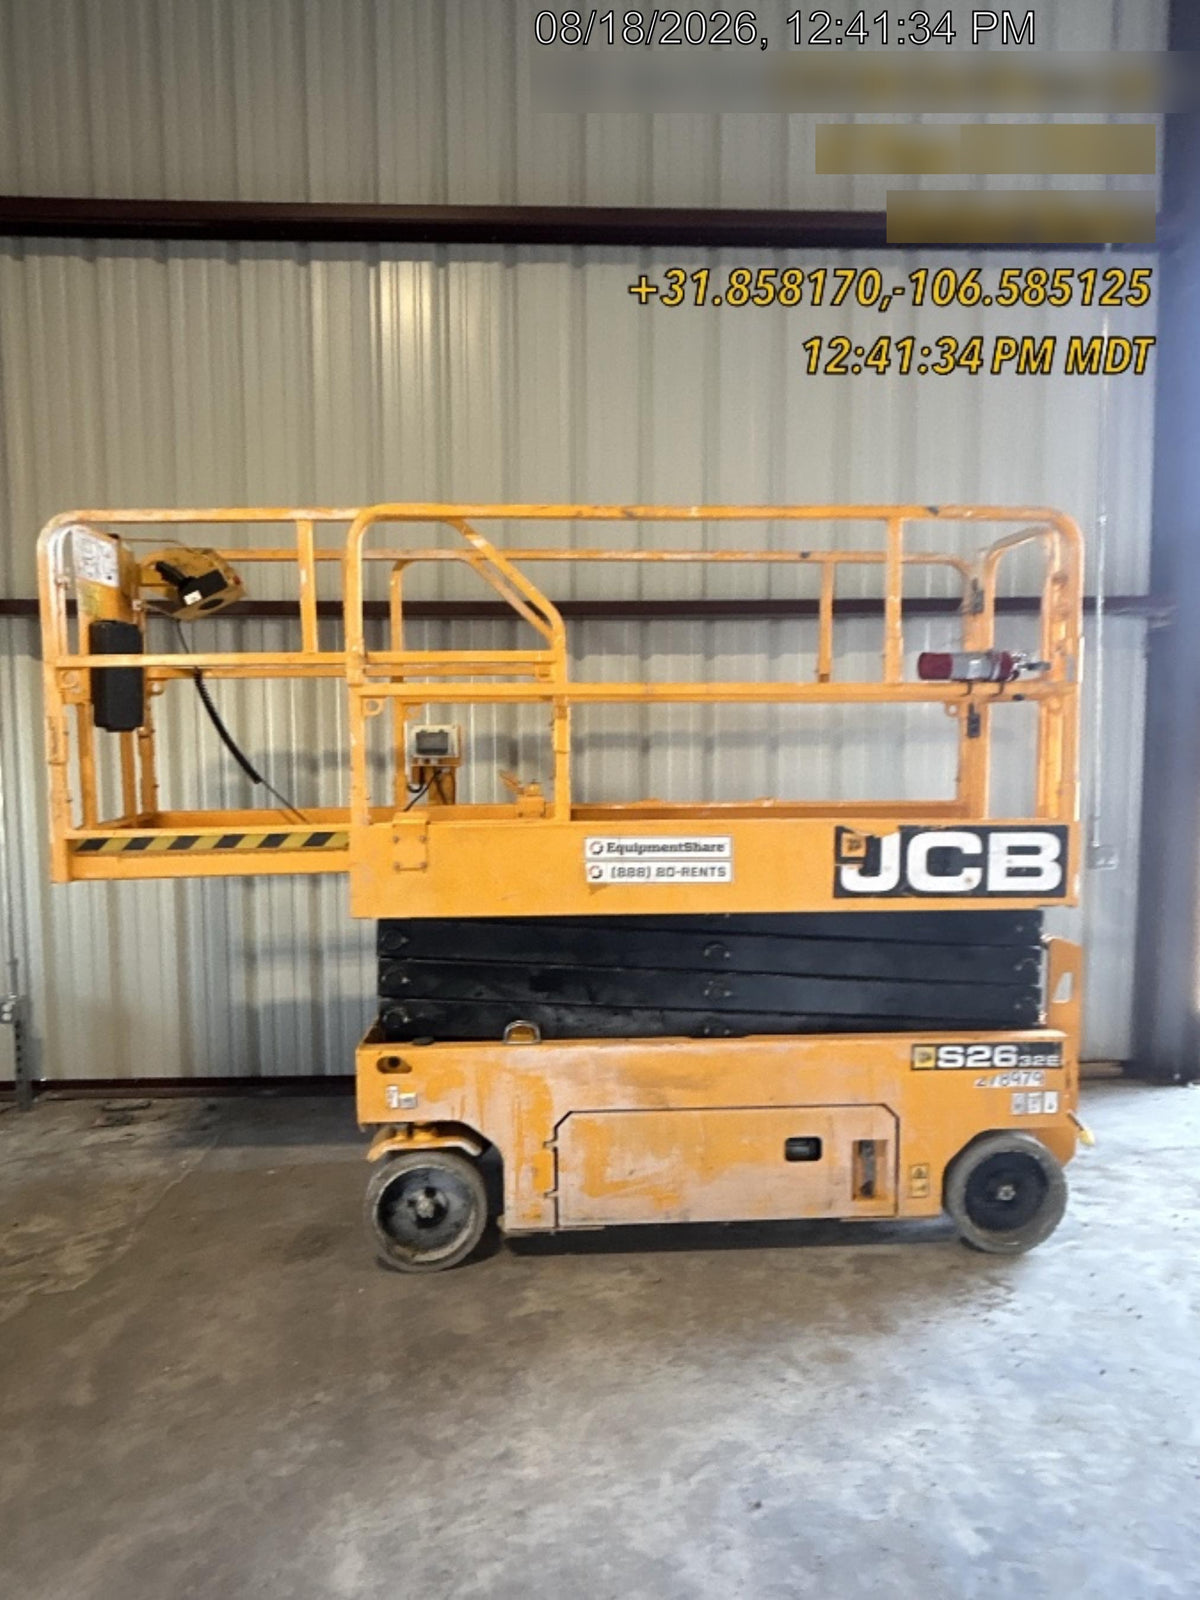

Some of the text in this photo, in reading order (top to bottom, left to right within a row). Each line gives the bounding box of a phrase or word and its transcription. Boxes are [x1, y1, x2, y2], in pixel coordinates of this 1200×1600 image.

[606, 841, 726, 856] EquipmentShare
[840, 831, 1062, 892] JCB
[610, 865, 653, 879] (888)
